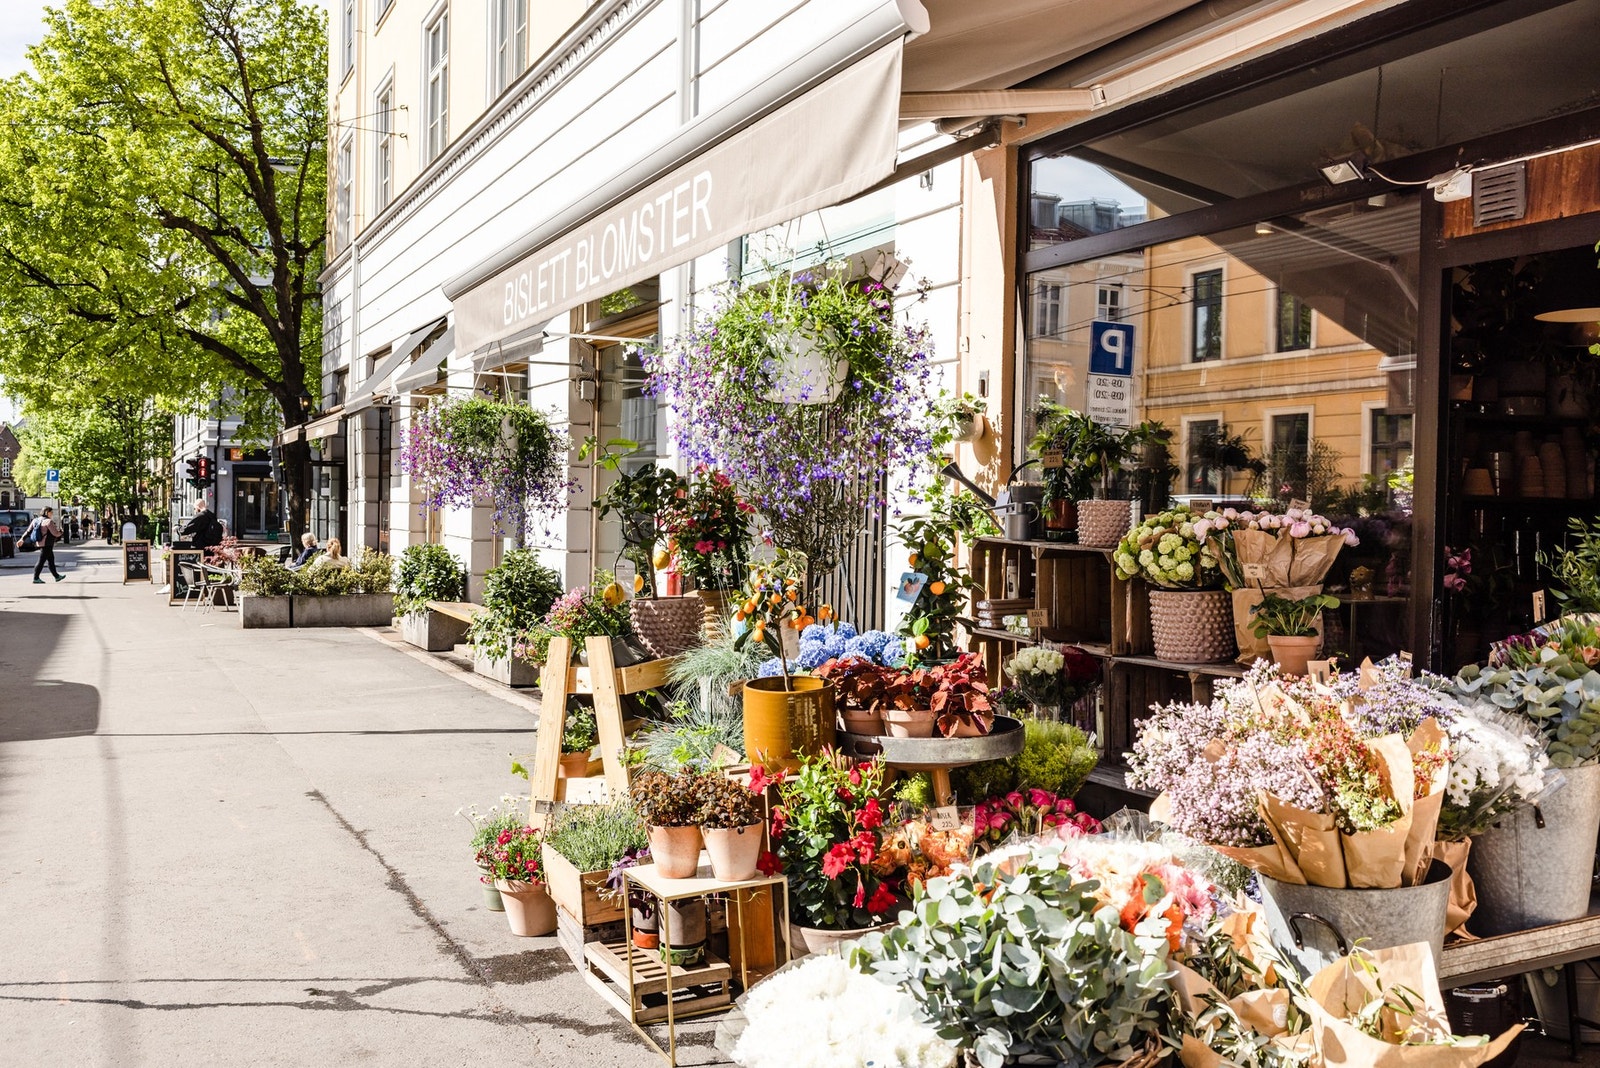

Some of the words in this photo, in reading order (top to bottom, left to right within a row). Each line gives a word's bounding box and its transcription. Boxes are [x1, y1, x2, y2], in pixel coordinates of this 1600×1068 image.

[503, 249, 571, 326] BISLETT
[576, 170, 712, 292] BLOMSTER
[49, 470, 57, 481] P
